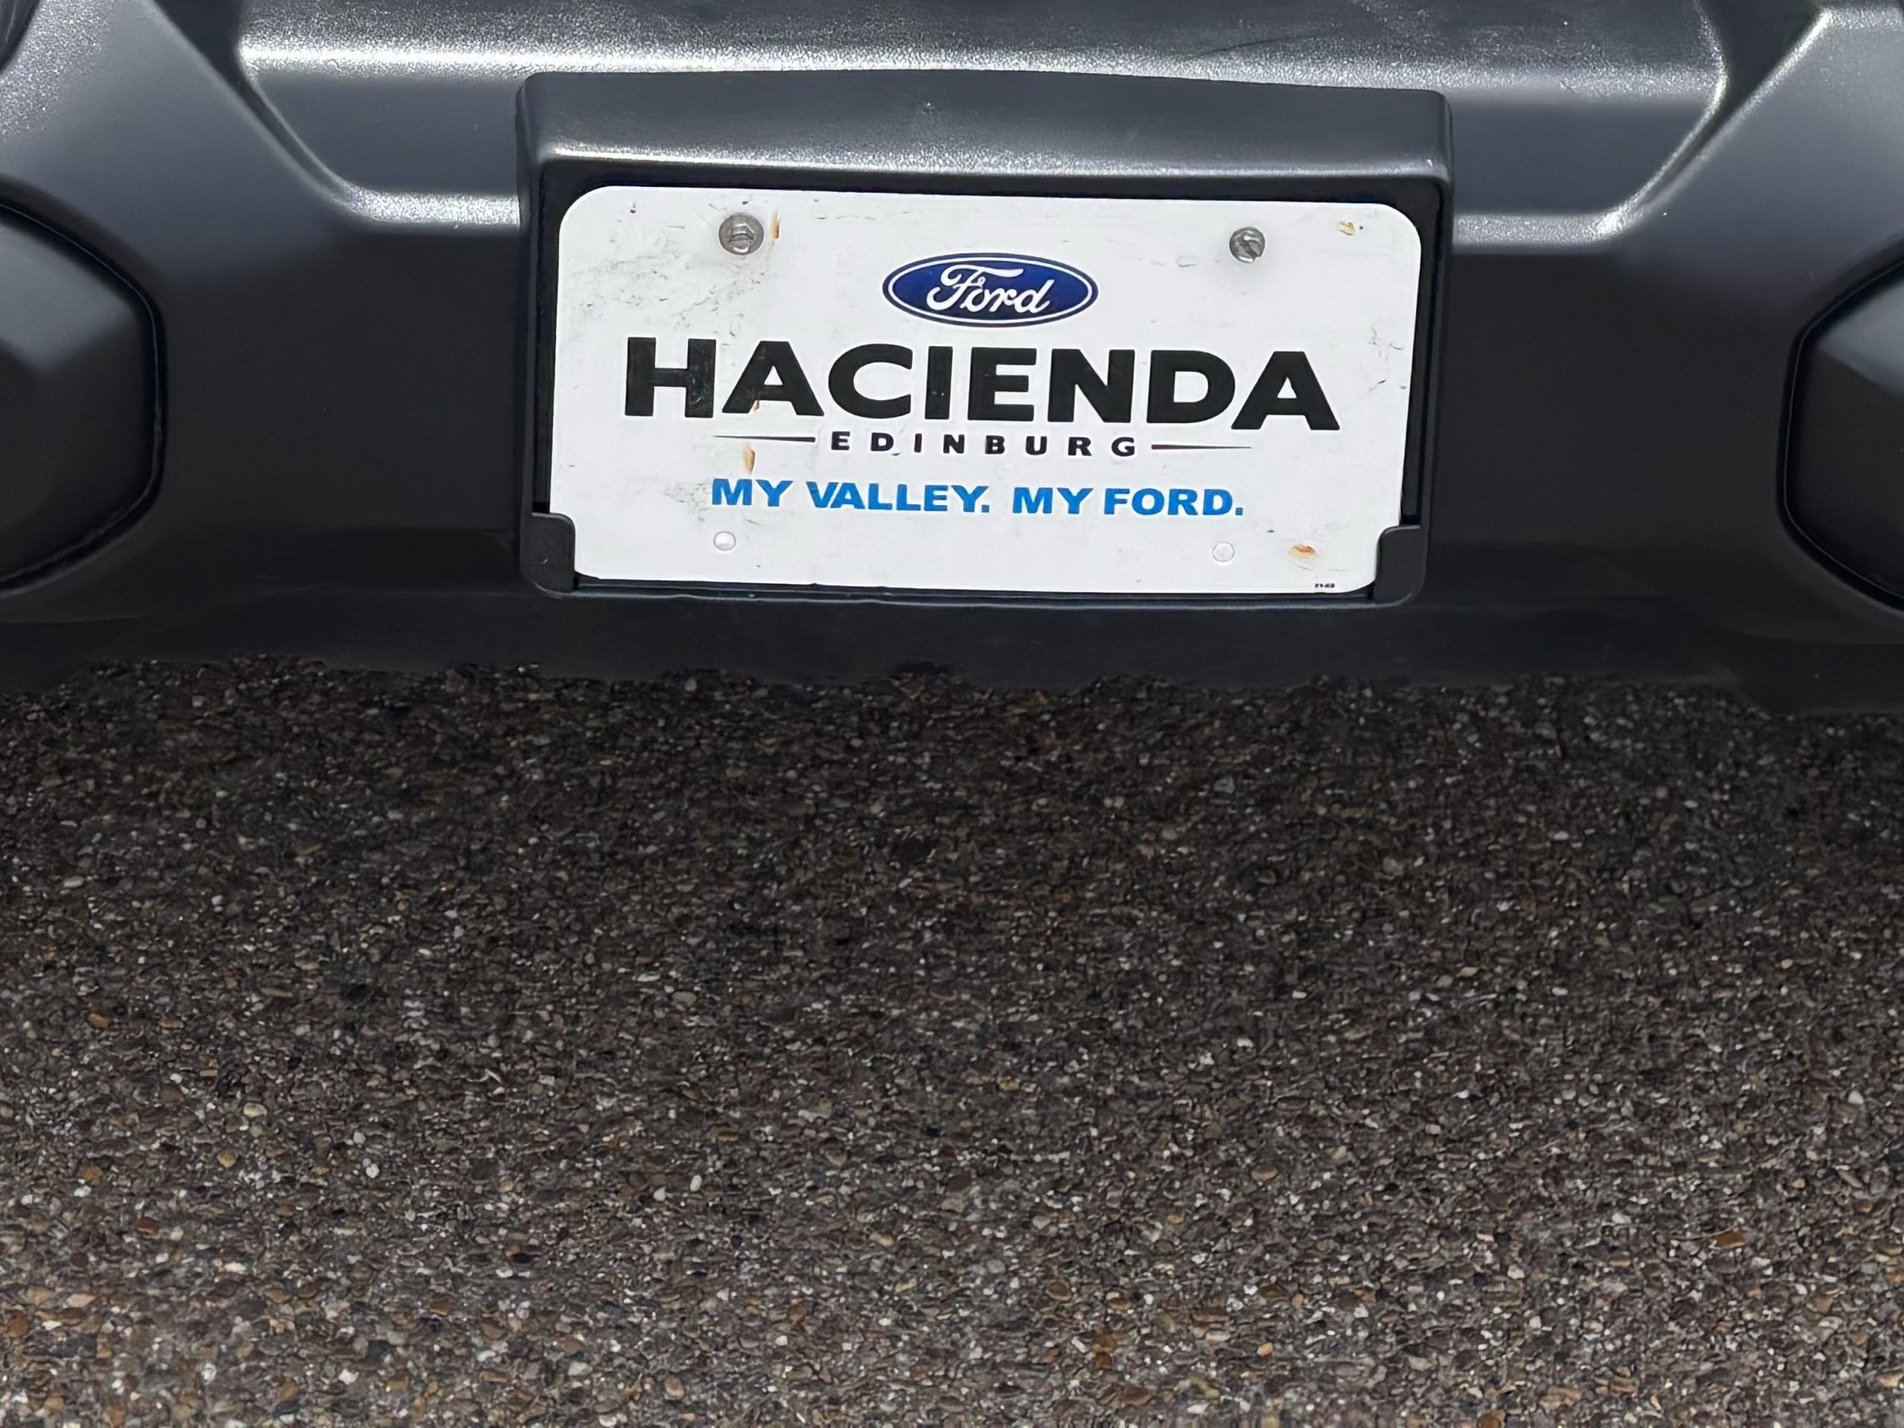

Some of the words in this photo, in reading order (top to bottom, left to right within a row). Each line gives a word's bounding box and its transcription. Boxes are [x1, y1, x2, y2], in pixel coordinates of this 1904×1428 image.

[926, 264, 1056, 316] Ford
[624, 336, 1342, 432] HACIENDA
[830, 430, 1138, 459] EDINBURG
[711, 478, 794, 508] MY
[805, 481, 992, 514] VALLEY.
[1012, 485, 1094, 516] MY
[1103, 487, 1246, 518] FORD.
